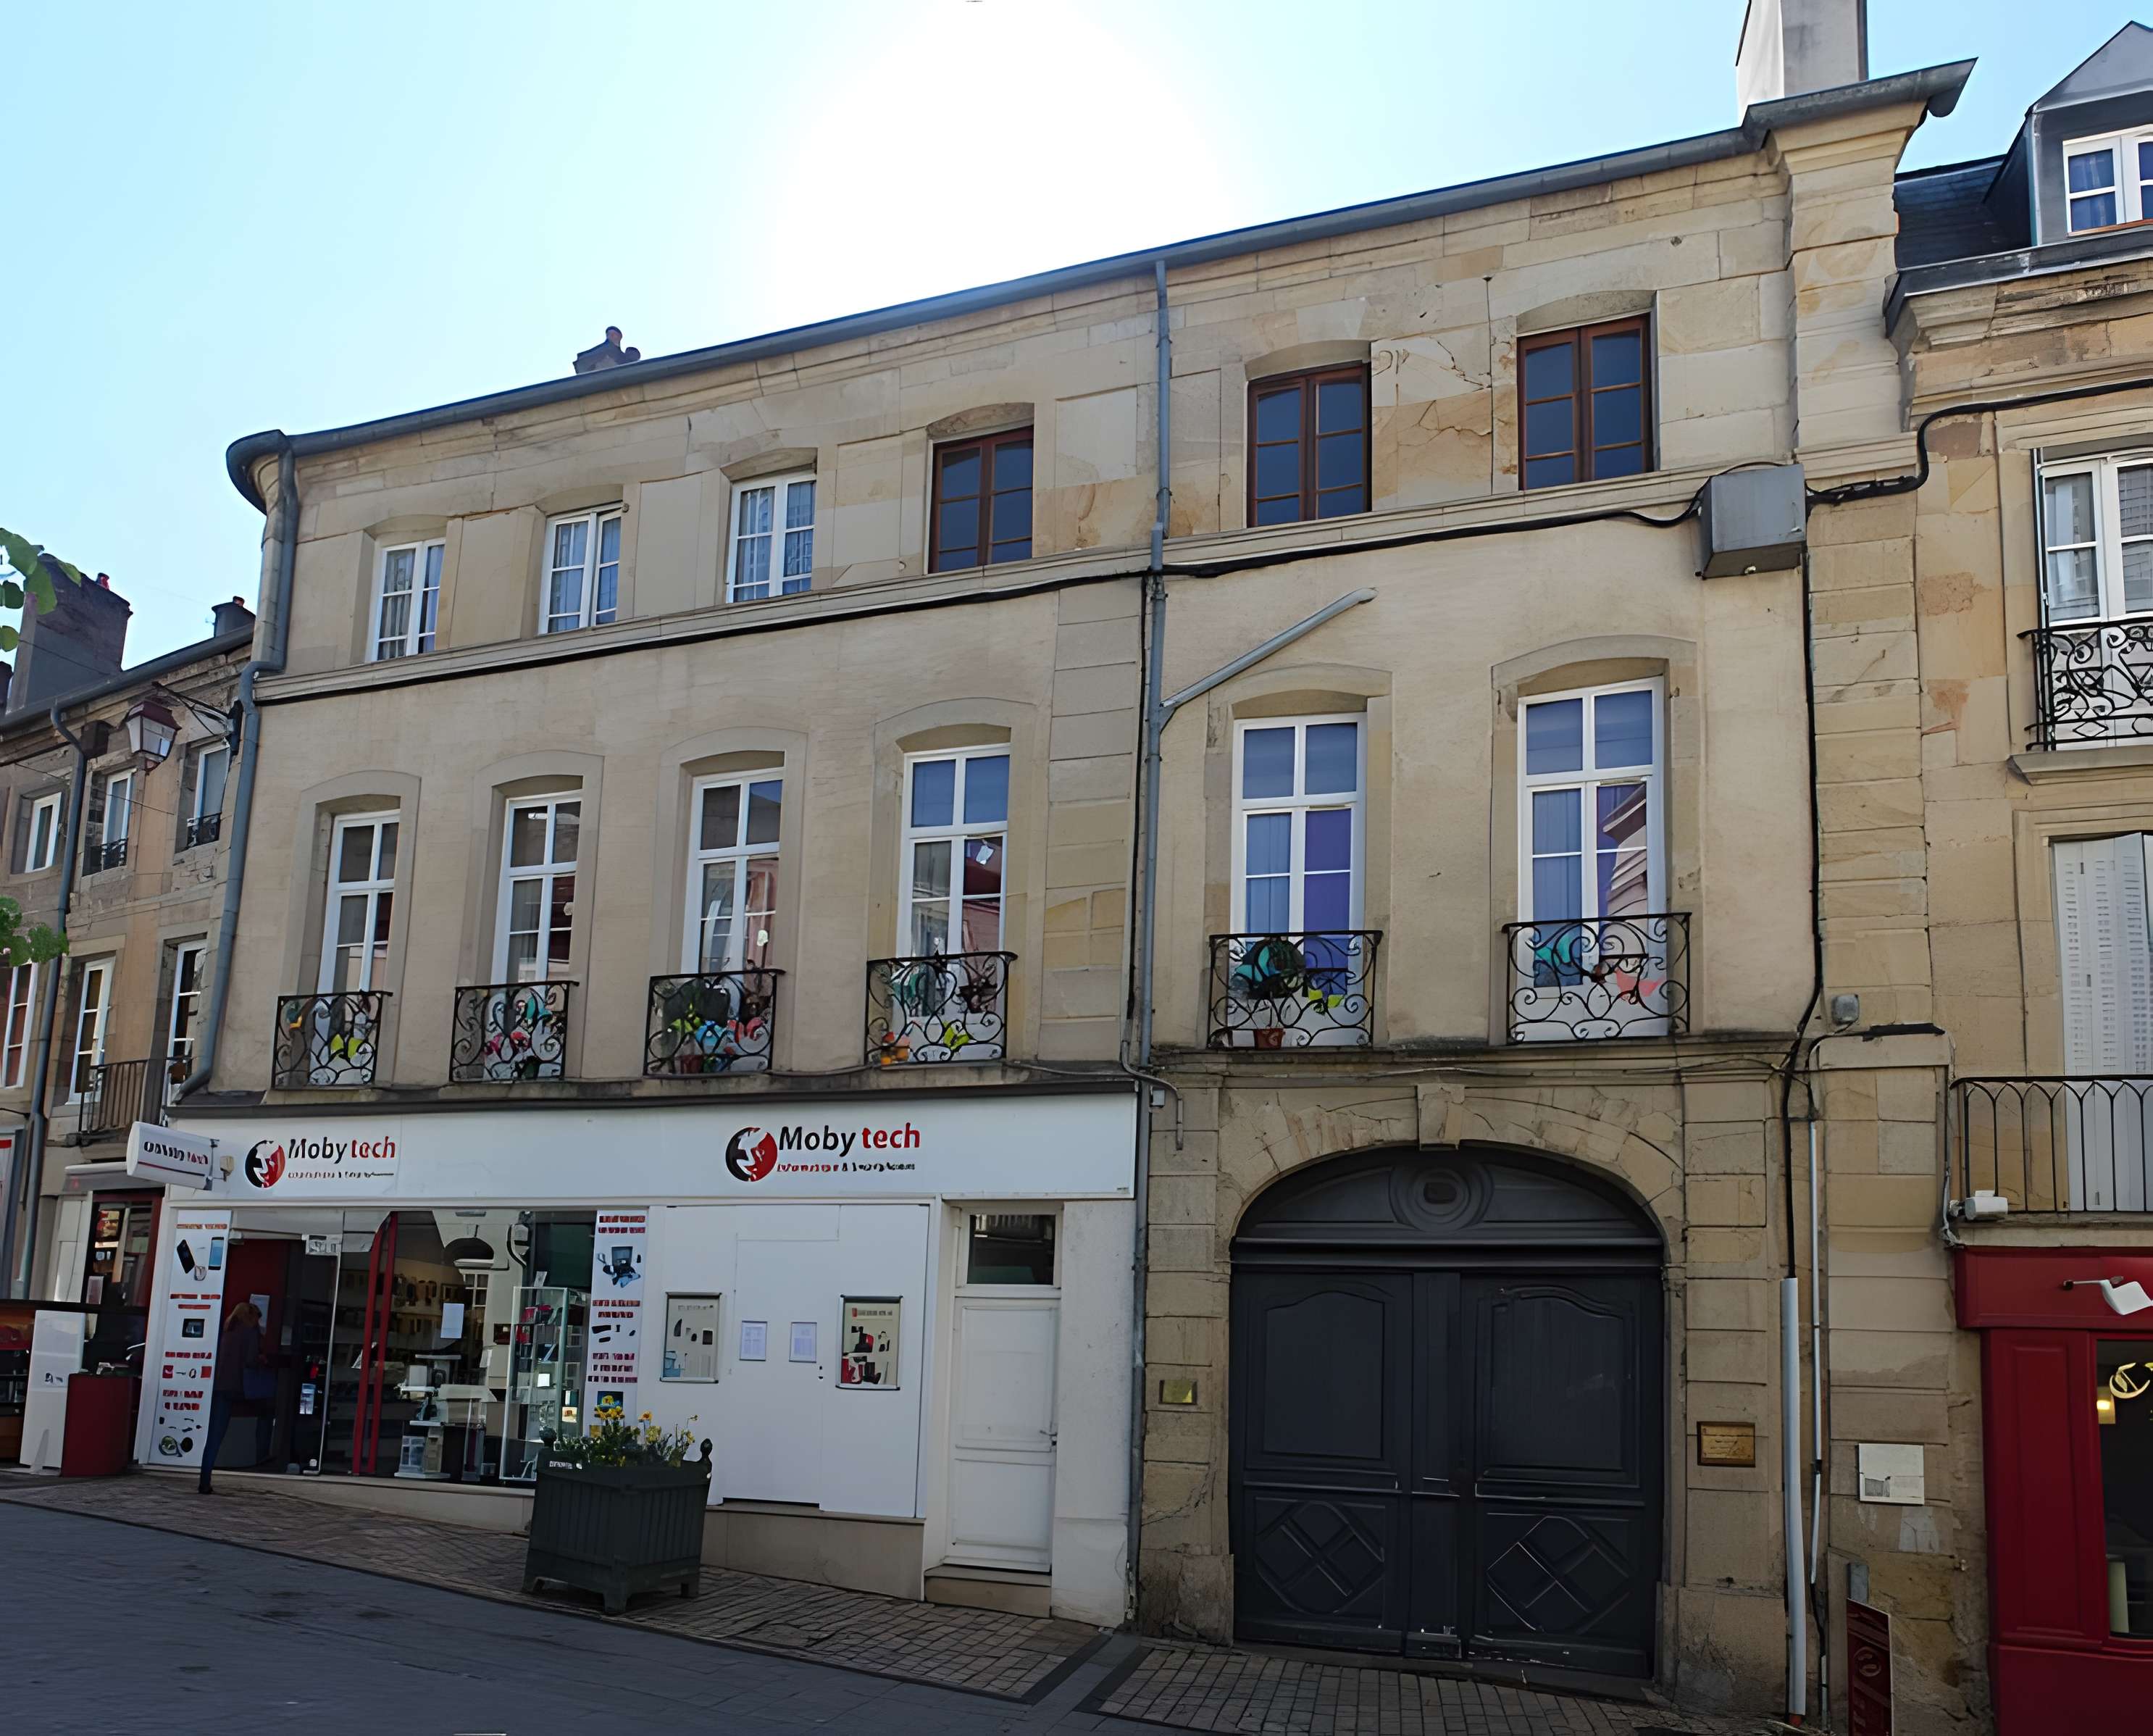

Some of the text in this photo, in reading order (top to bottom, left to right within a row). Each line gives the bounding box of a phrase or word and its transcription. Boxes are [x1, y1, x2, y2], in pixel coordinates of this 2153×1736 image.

[288, 1136, 348, 1164] Moby
[779, 1122, 921, 1157] Moby tech
